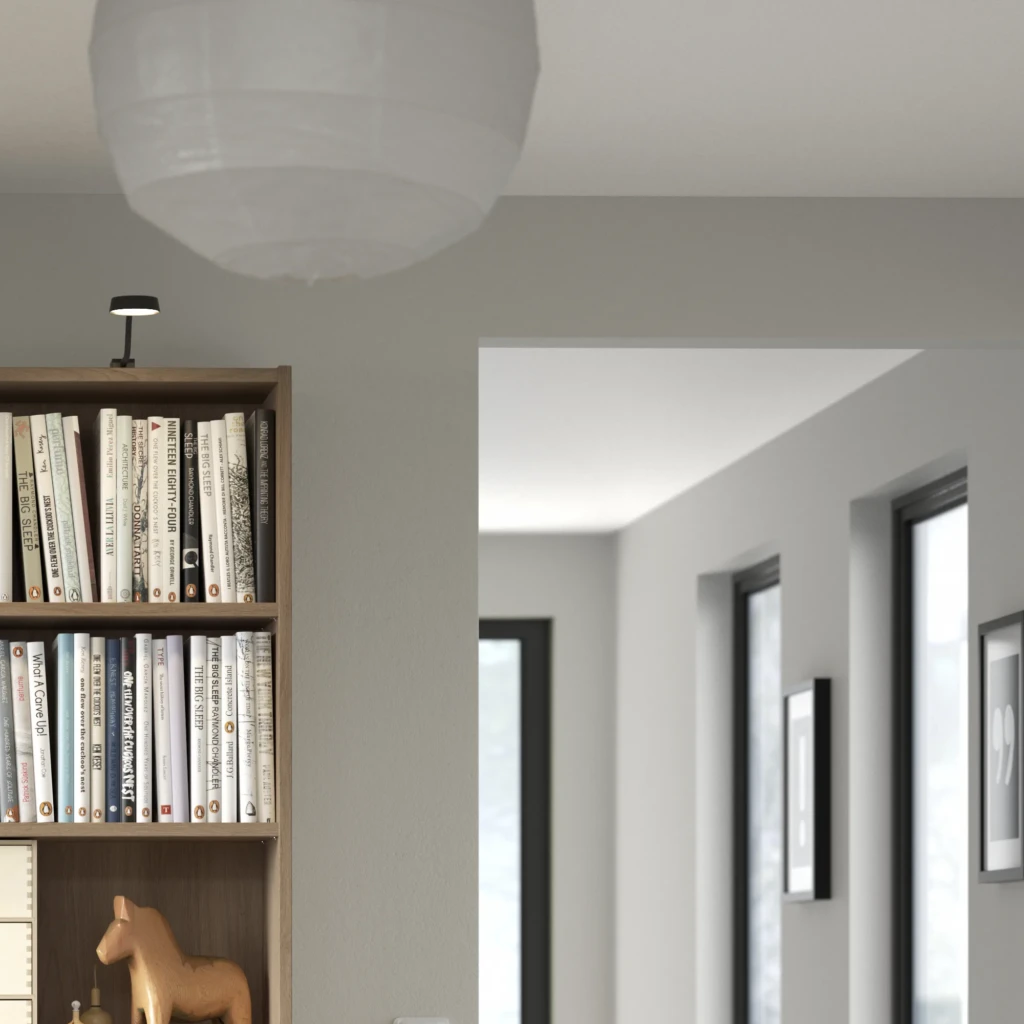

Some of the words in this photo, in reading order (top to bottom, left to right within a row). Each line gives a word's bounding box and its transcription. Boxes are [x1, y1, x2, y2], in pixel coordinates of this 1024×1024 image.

[106, 414, 114, 436] Miguel
[260, 421, 268, 440] KONRAD
[167, 421, 177, 466] NINETEEN
[184, 433, 193, 458] SLEEP
[200, 434, 209, 451] THE
[260, 441, 268, 459] LORENZ
[201, 453, 210, 468] BIG
[18, 471, 28, 491] THE
[260, 469, 268, 478] THE
[202, 470, 211, 497] SLEEP
[260, 479, 268, 505] IMPRINTING
[20, 497, 30, 513] BIG
[167, 469, 177, 532] EIGHTY-FOUR
[260, 506, 268, 524] THEORY
[23, 519, 33, 552] SLEEP
[32, 654, 43, 675] What
[195, 666, 203, 685] THE
[225, 666, 233, 685] Island
[34, 690, 45, 718] Carve
[195, 687, 203, 702] BIG
[195, 704, 203, 730] SLEEP
[36, 720, 47, 736] Up!
[92, 744, 102, 753] KEN
[92, 756, 102, 770] KESEY
